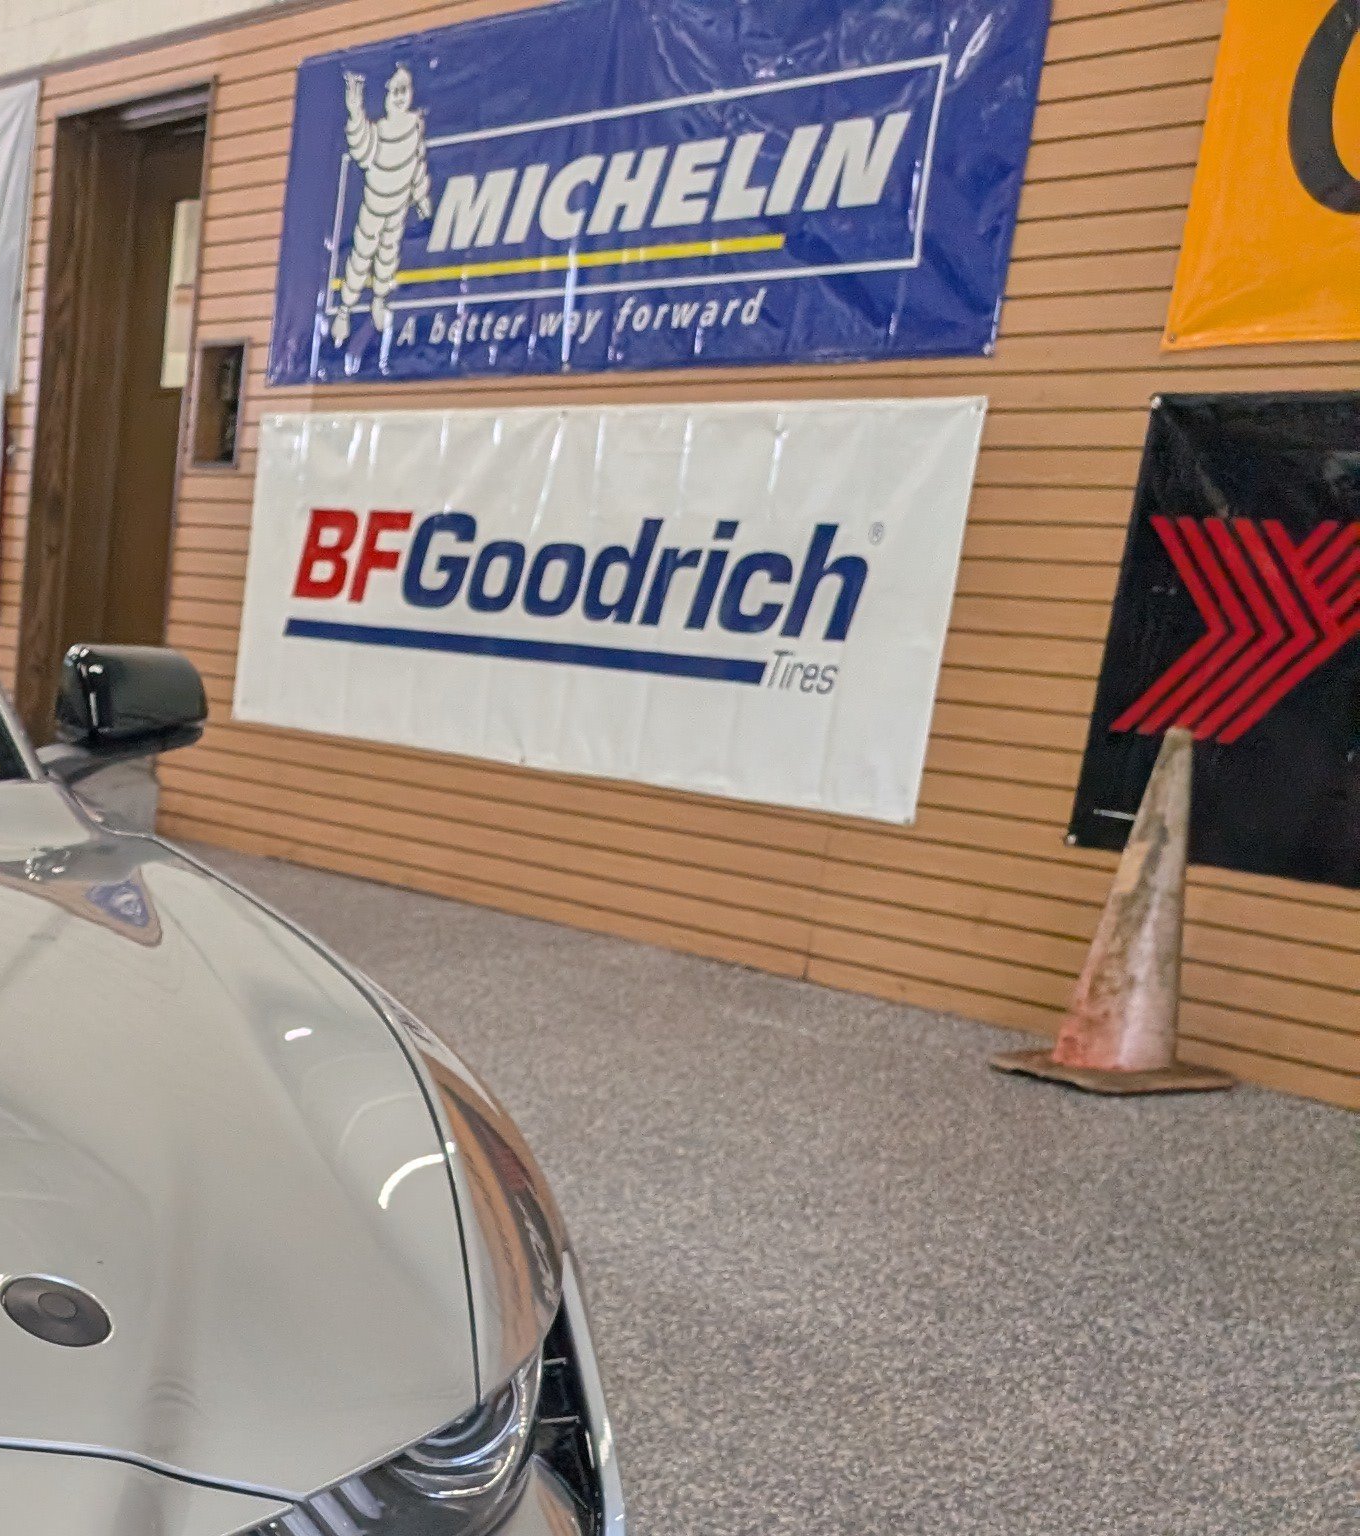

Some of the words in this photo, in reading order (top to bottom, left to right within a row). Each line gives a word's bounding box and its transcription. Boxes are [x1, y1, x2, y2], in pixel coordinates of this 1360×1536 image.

[426, 110, 912, 254] MICHELIN
[396, 315, 417, 347] A
[429, 310, 527, 347] better
[538, 307, 603, 345] way
[615, 285, 768, 333] forward
[766, 648, 840, 695] Tires
